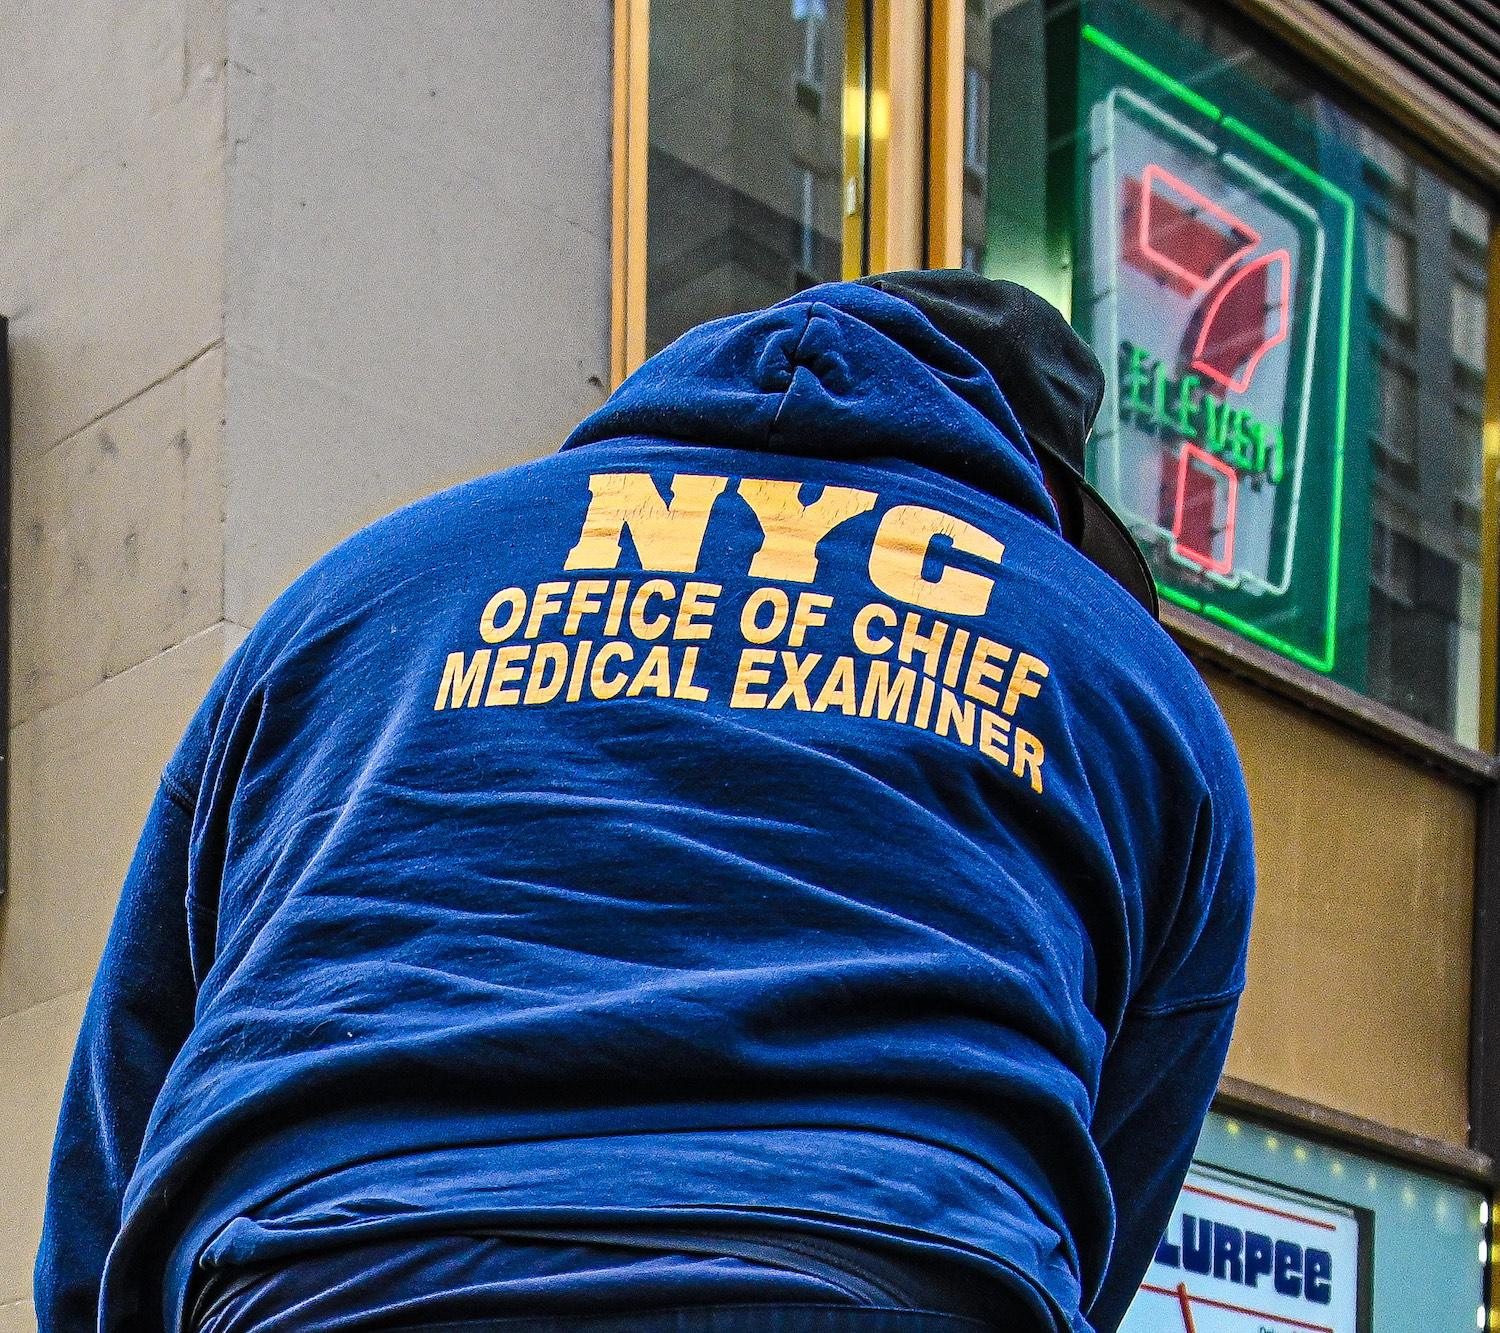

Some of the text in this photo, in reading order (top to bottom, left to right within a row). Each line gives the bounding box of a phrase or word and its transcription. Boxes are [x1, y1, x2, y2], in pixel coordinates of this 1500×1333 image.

[563, 472, 1006, 617] NYC
[433, 641, 1046, 795] MEDICAL EXAMINER
[478, 579, 1051, 714] OFFICE OF CHIEF
